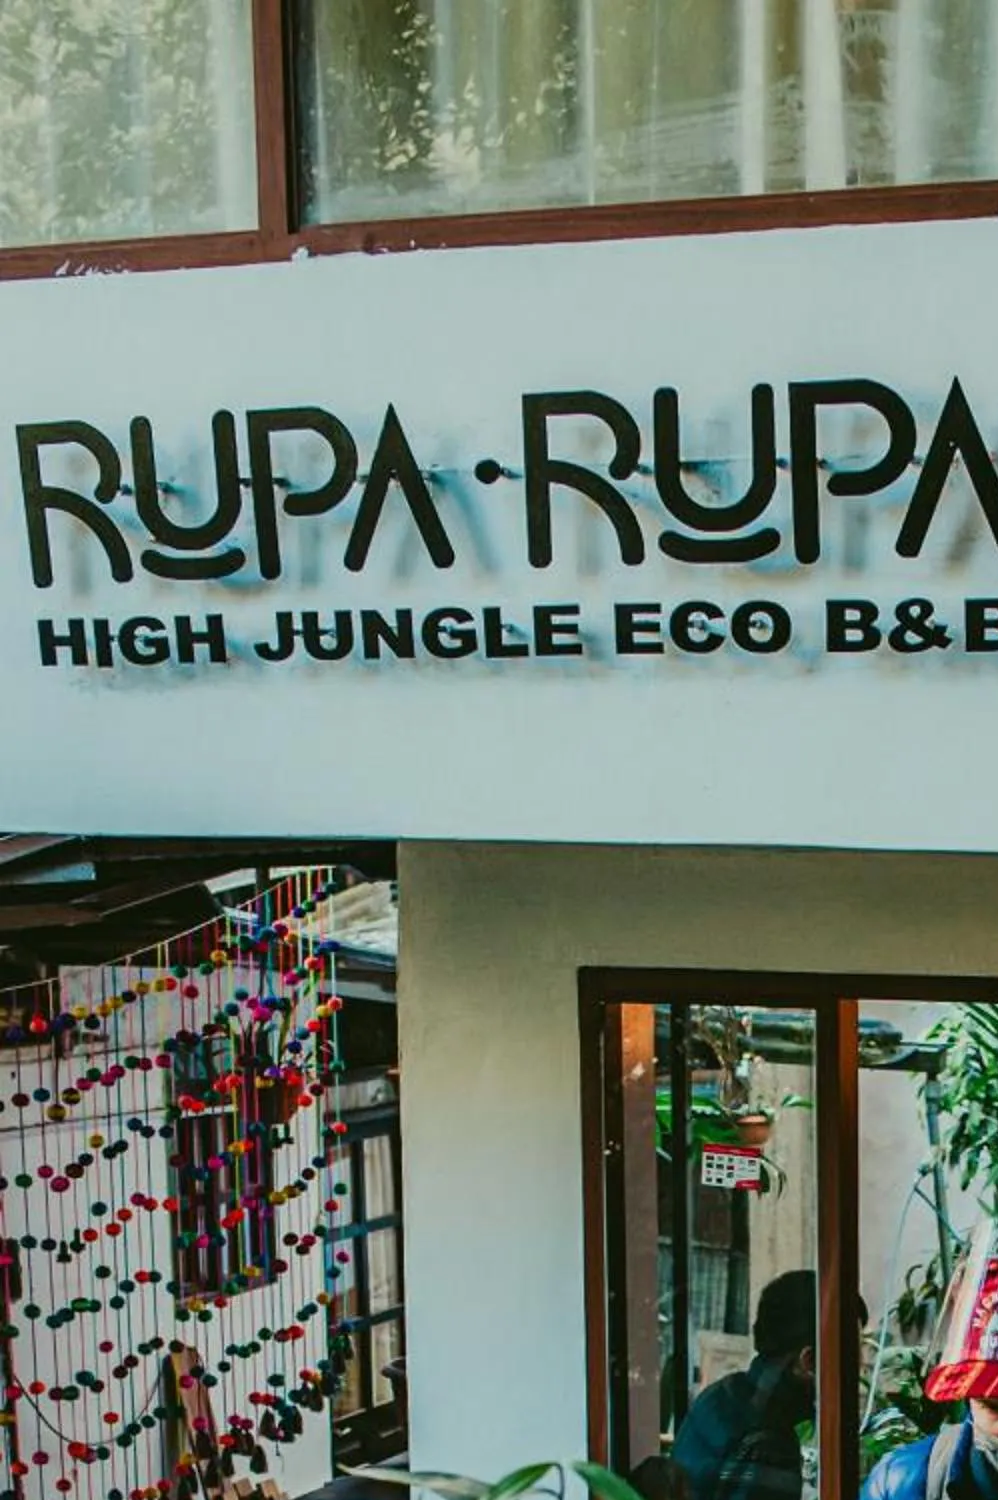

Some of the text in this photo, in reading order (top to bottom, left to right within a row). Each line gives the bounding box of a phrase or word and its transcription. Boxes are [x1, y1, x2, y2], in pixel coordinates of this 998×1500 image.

[16, 404, 455, 588] RUPA
[39, 615, 228, 667] HIGH
[255, 605, 583, 661] JUNGLE
[615, 602, 791, 654] ECO
